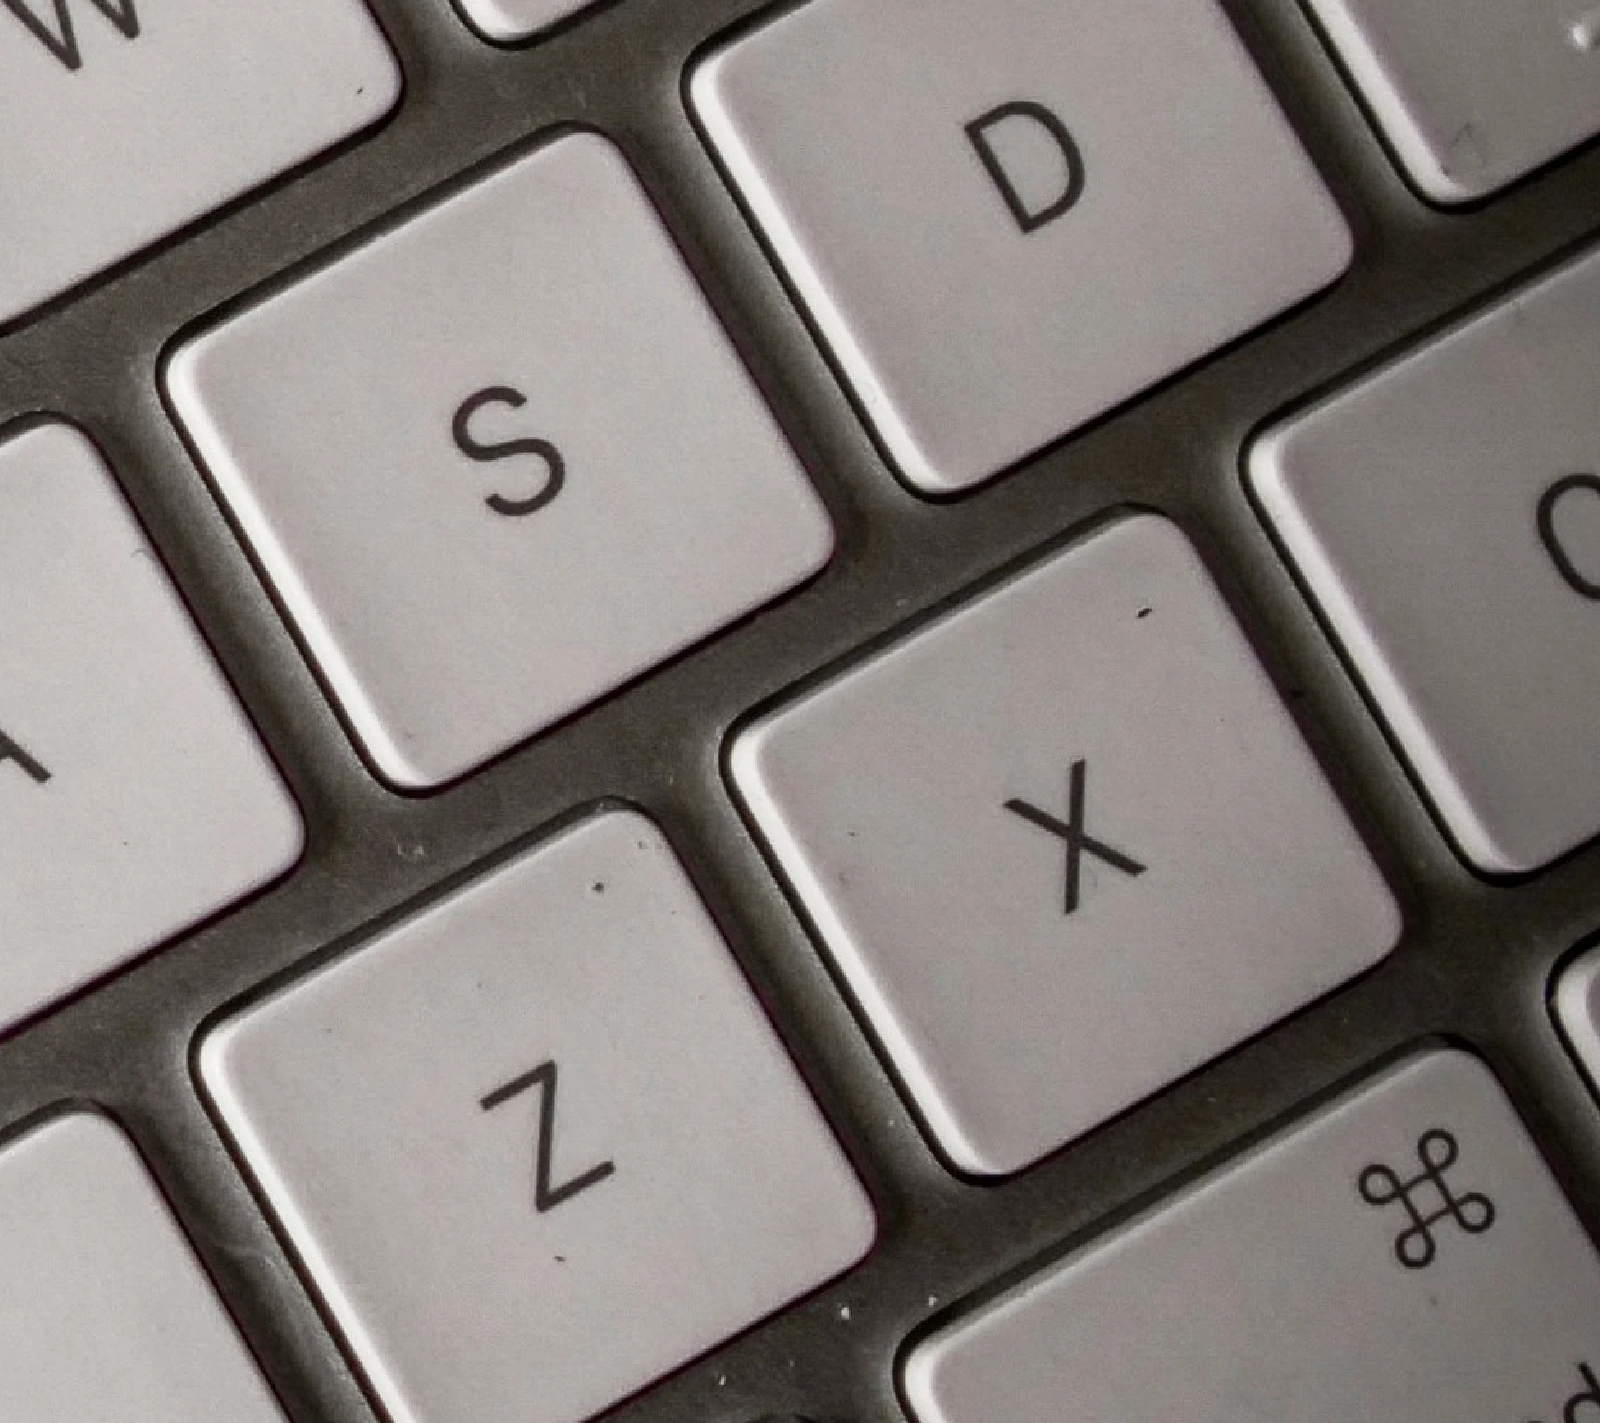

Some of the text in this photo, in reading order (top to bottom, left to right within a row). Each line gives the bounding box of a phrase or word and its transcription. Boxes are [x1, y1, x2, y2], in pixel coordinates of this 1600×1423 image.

[964, 101, 1085, 235] D
[452, 386, 565, 517] S
[1003, 759, 1148, 914] X
[480, 1060, 616, 1213] Z
